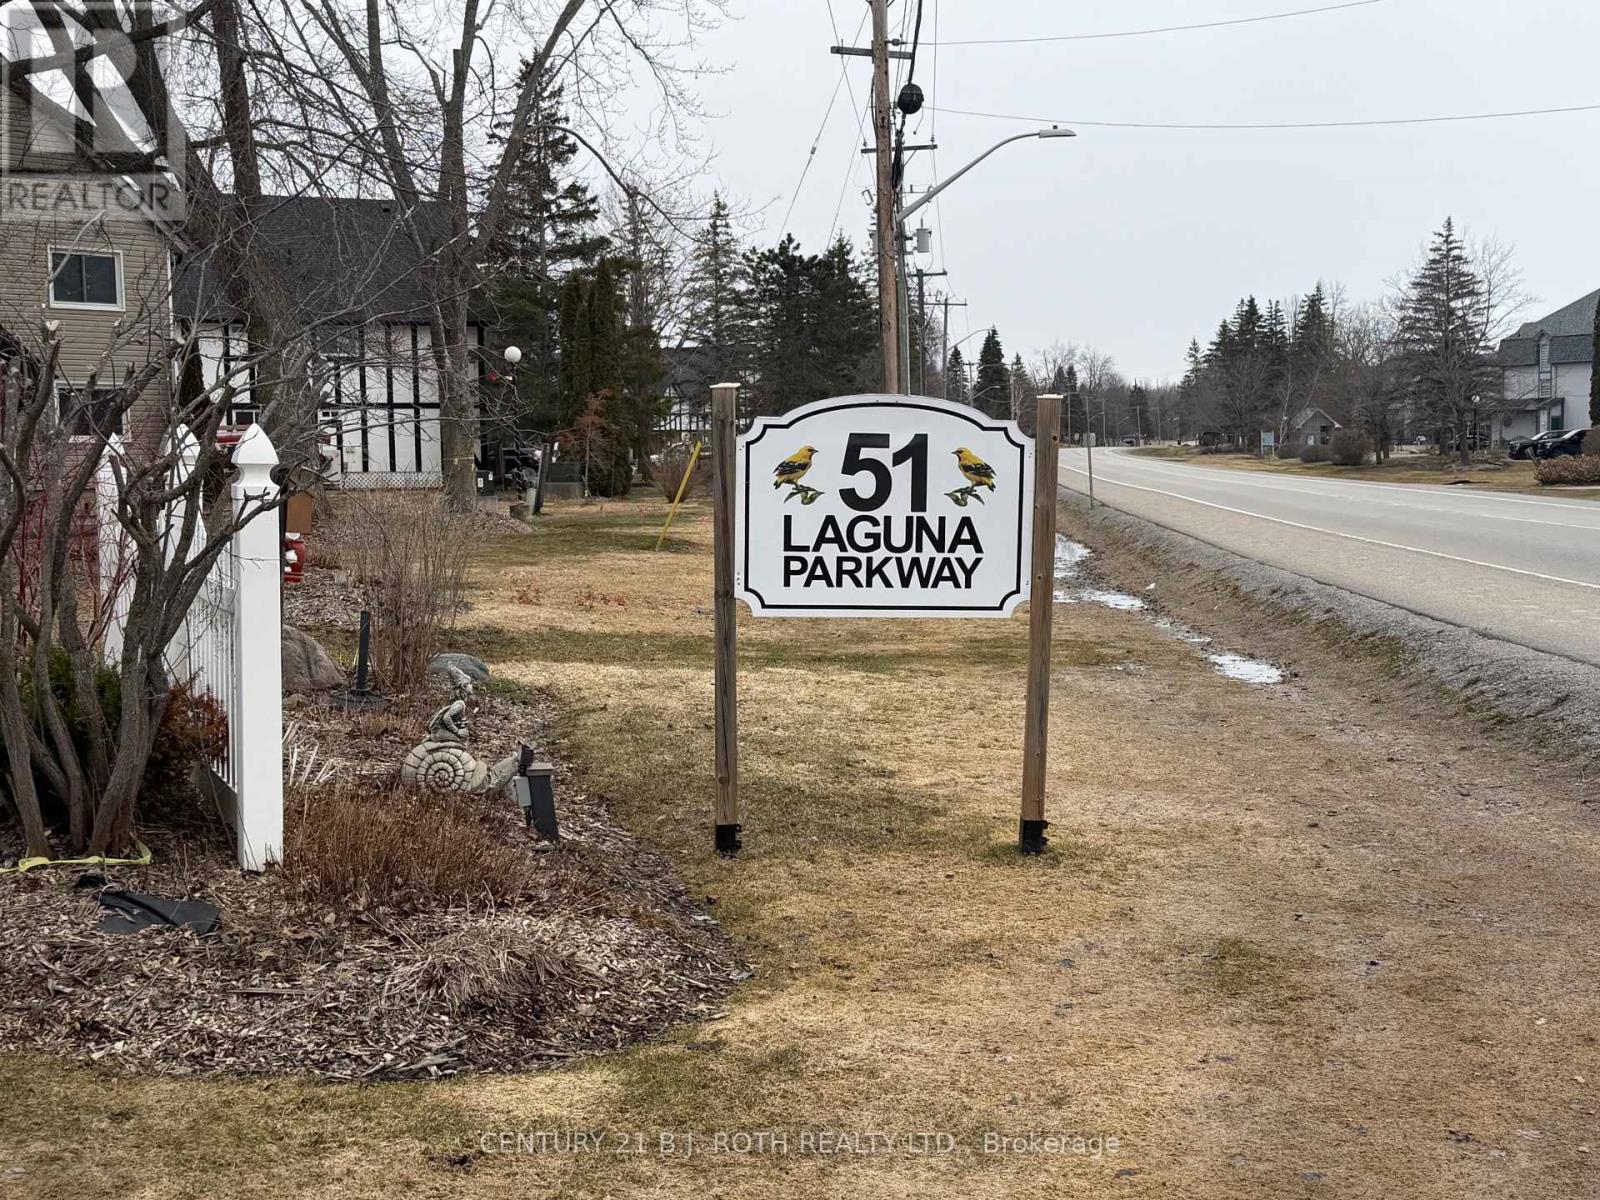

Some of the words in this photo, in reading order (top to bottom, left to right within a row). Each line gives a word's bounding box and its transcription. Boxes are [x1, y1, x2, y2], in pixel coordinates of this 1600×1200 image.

[838, 432, 929, 513] 51
[782, 514, 984, 554] LAGUNA
[782, 555, 984, 589] PARKWAY
